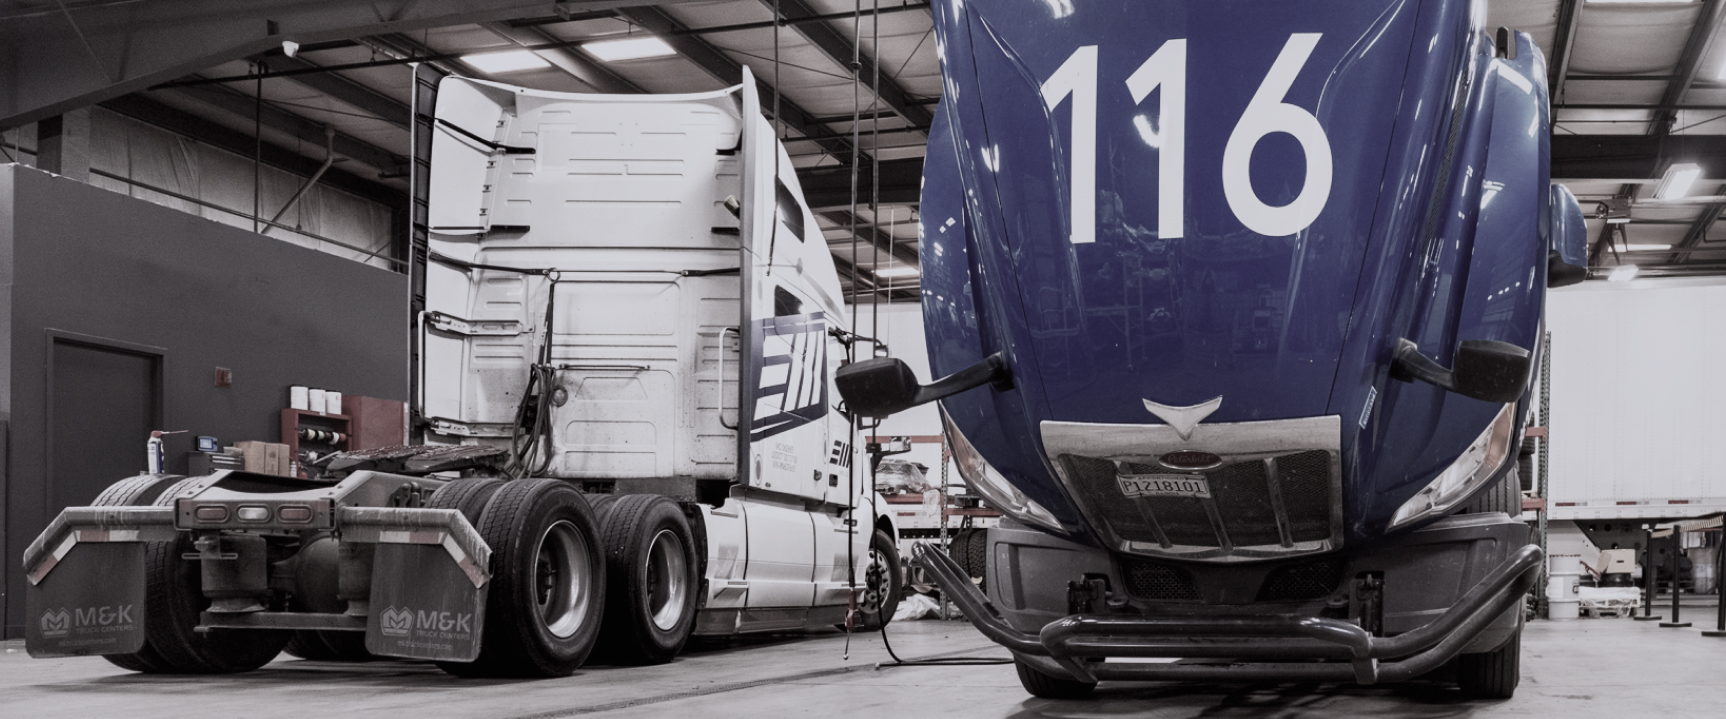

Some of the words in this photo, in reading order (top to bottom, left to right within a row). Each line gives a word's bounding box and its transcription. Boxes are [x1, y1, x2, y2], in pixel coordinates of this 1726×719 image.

[1041, 32, 1333, 244] 116
[1168, 453, 1215, 464] Peterbilt
[1123, 480, 1205, 493] P1218101
[75, 604, 133, 627] M&K
[416, 609, 472, 633] M&K
[100, 625, 134, 633] CENTERS
[439, 632, 471, 640] CENTERS
